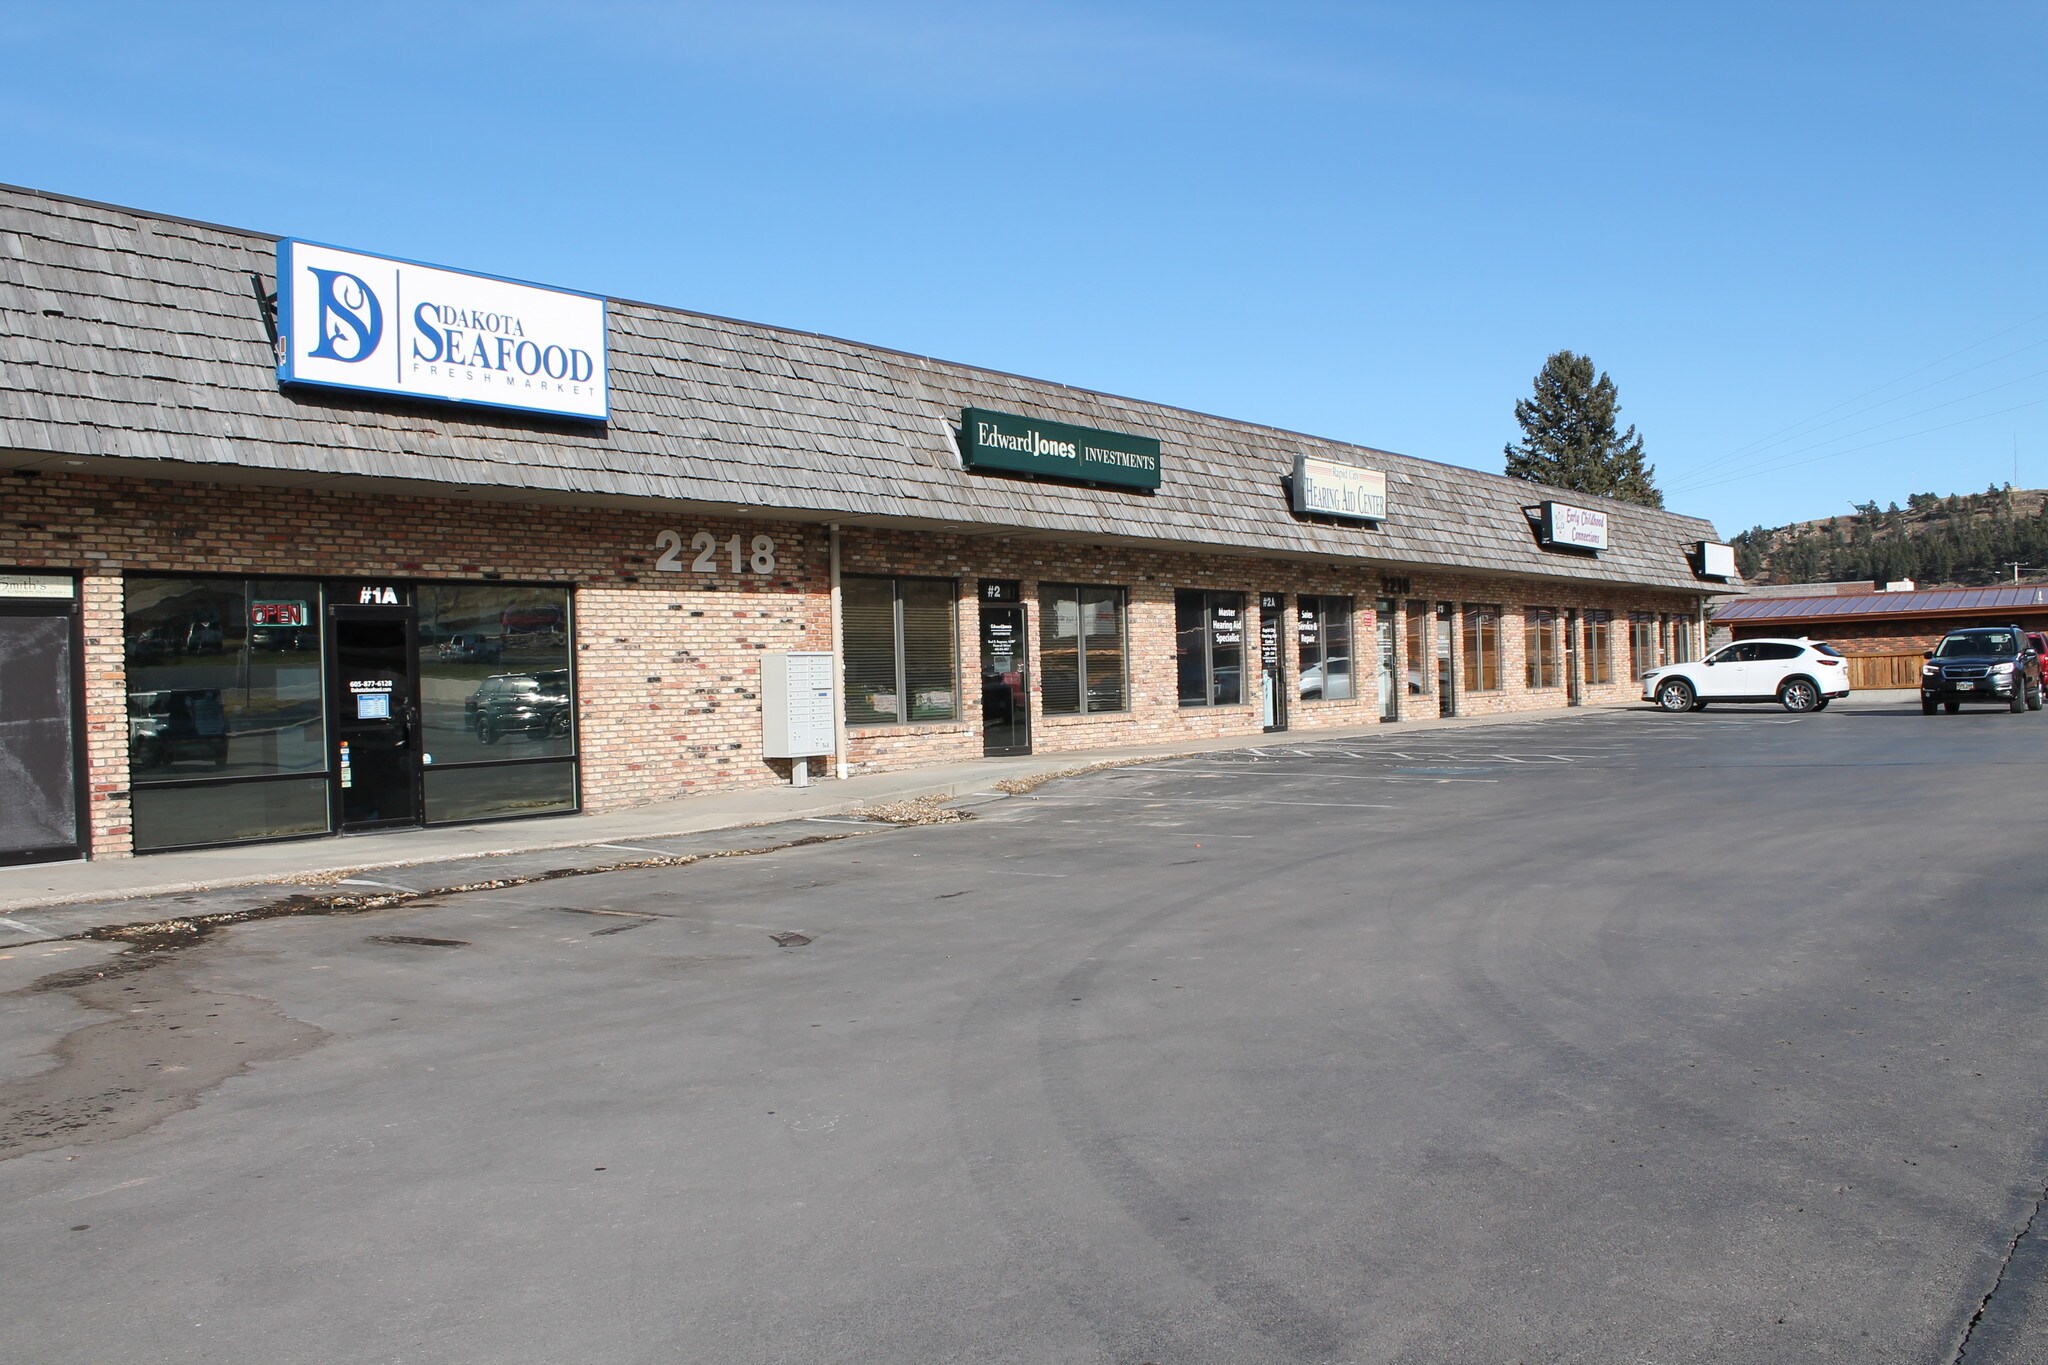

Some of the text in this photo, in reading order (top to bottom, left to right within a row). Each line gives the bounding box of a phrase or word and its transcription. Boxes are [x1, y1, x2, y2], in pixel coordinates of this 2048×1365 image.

[440, 304, 525, 337] DAKOTA
[413, 302, 593, 383] SEAFOOD
[413, 363, 595, 396] FRESH MARKET
[1084, 446, 1155, 471] INVESTMENTS
[1305, 478, 1385, 516] HEARING AID CENTER
[1566, 508, 1605, 527] Early Childhood
[1572, 526, 1600, 543] Connections
[655, 529, 775, 575] 2218
[360, 586, 398, 604] #1A
[987, 585, 1001, 598] #2
[1263, 597, 1276, 608] #2A
[251, 604, 300, 624] OPEN
[1218, 608, 1236, 617] Master
[1301, 610, 1313, 619] Sales
[1213, 620, 1242, 631] Hearing Aid
[1298, 621, 1313, 631] Service
[1216, 633, 1240, 644] Specialist
[1301, 634, 1316, 644] Repair
[350, 680, 393, 688] 605-877-6128
